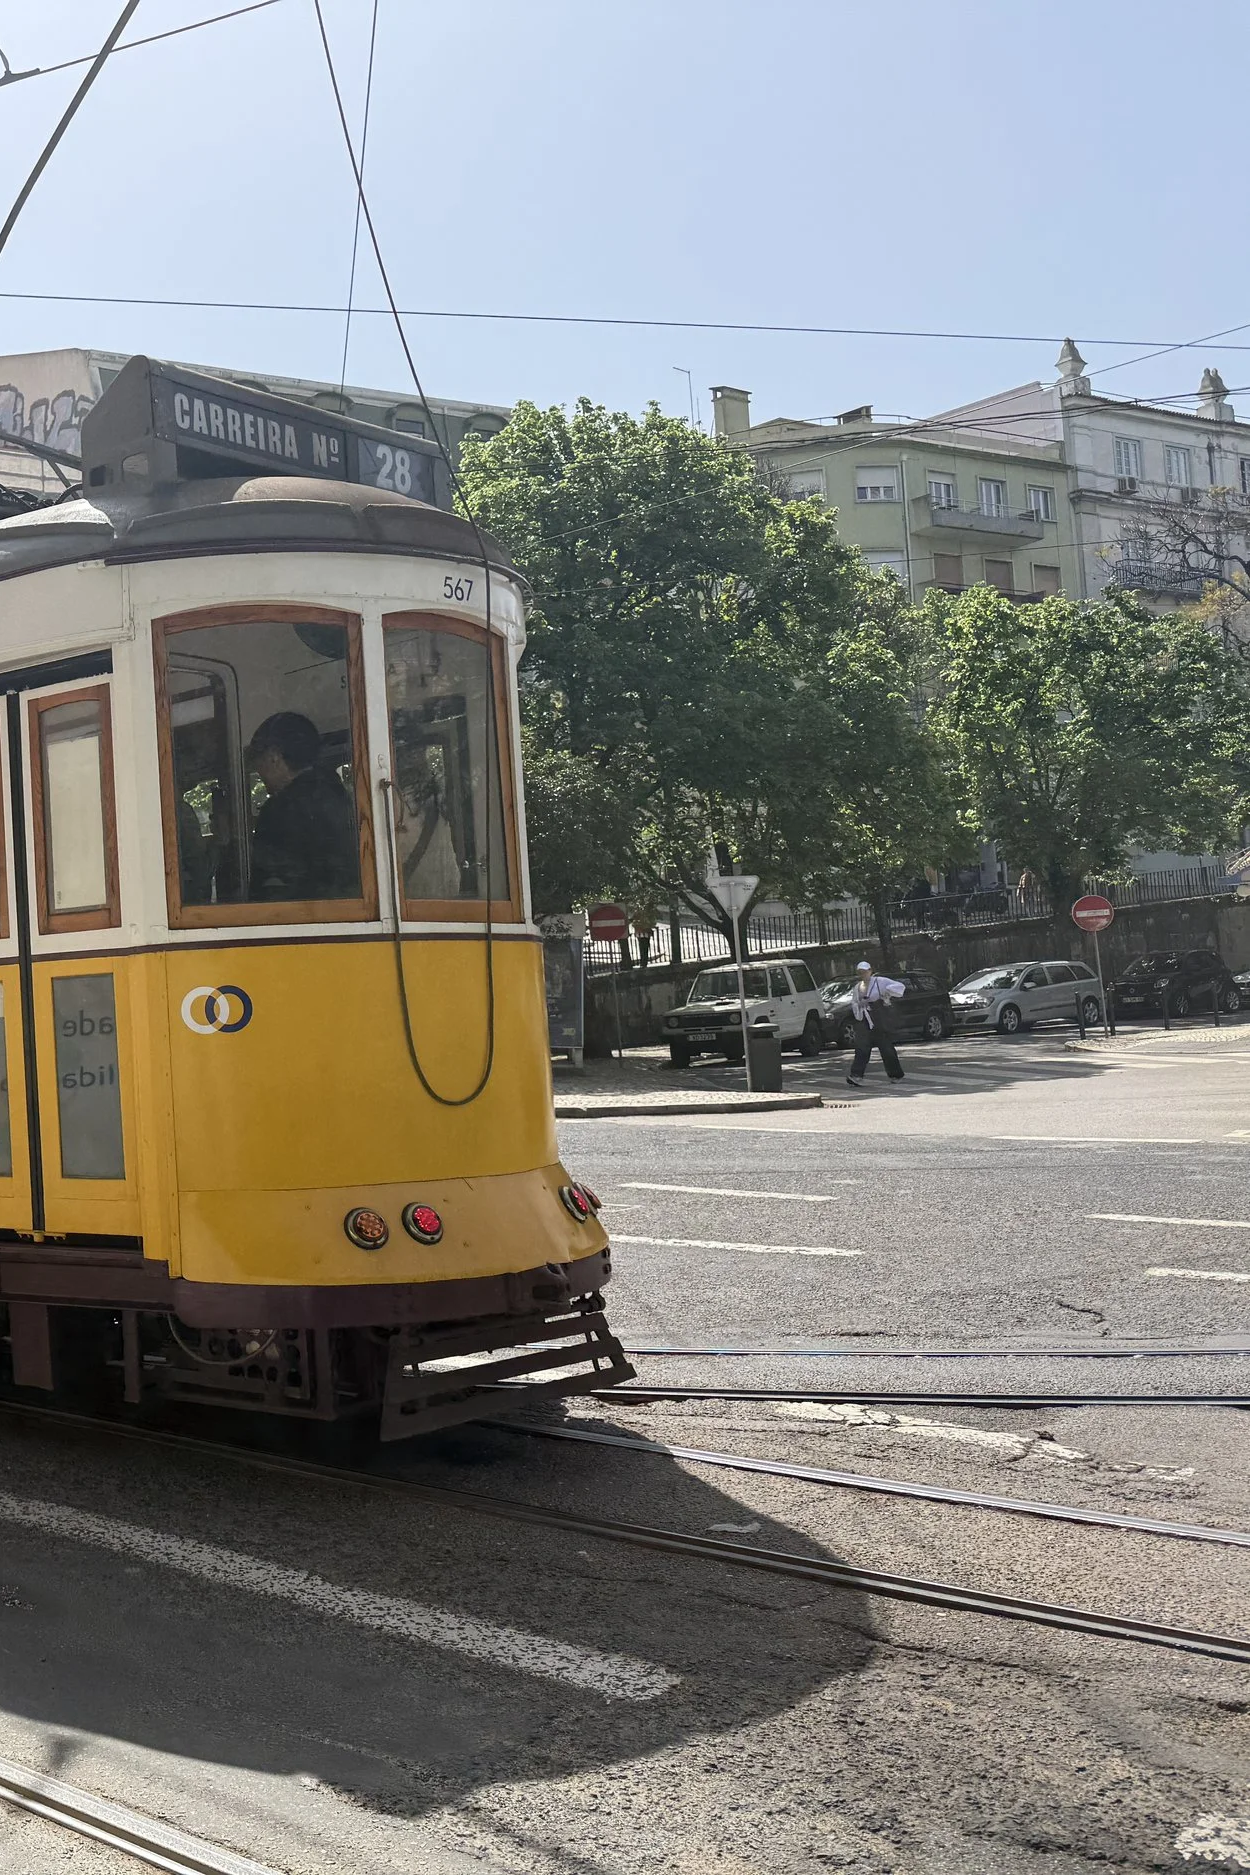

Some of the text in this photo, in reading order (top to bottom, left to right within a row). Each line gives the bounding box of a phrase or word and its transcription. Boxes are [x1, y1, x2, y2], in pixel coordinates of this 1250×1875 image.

[174, 393, 299, 460] CARREIRA
[375, 444, 412, 494] 28
[443, 576, 473, 601] 567
